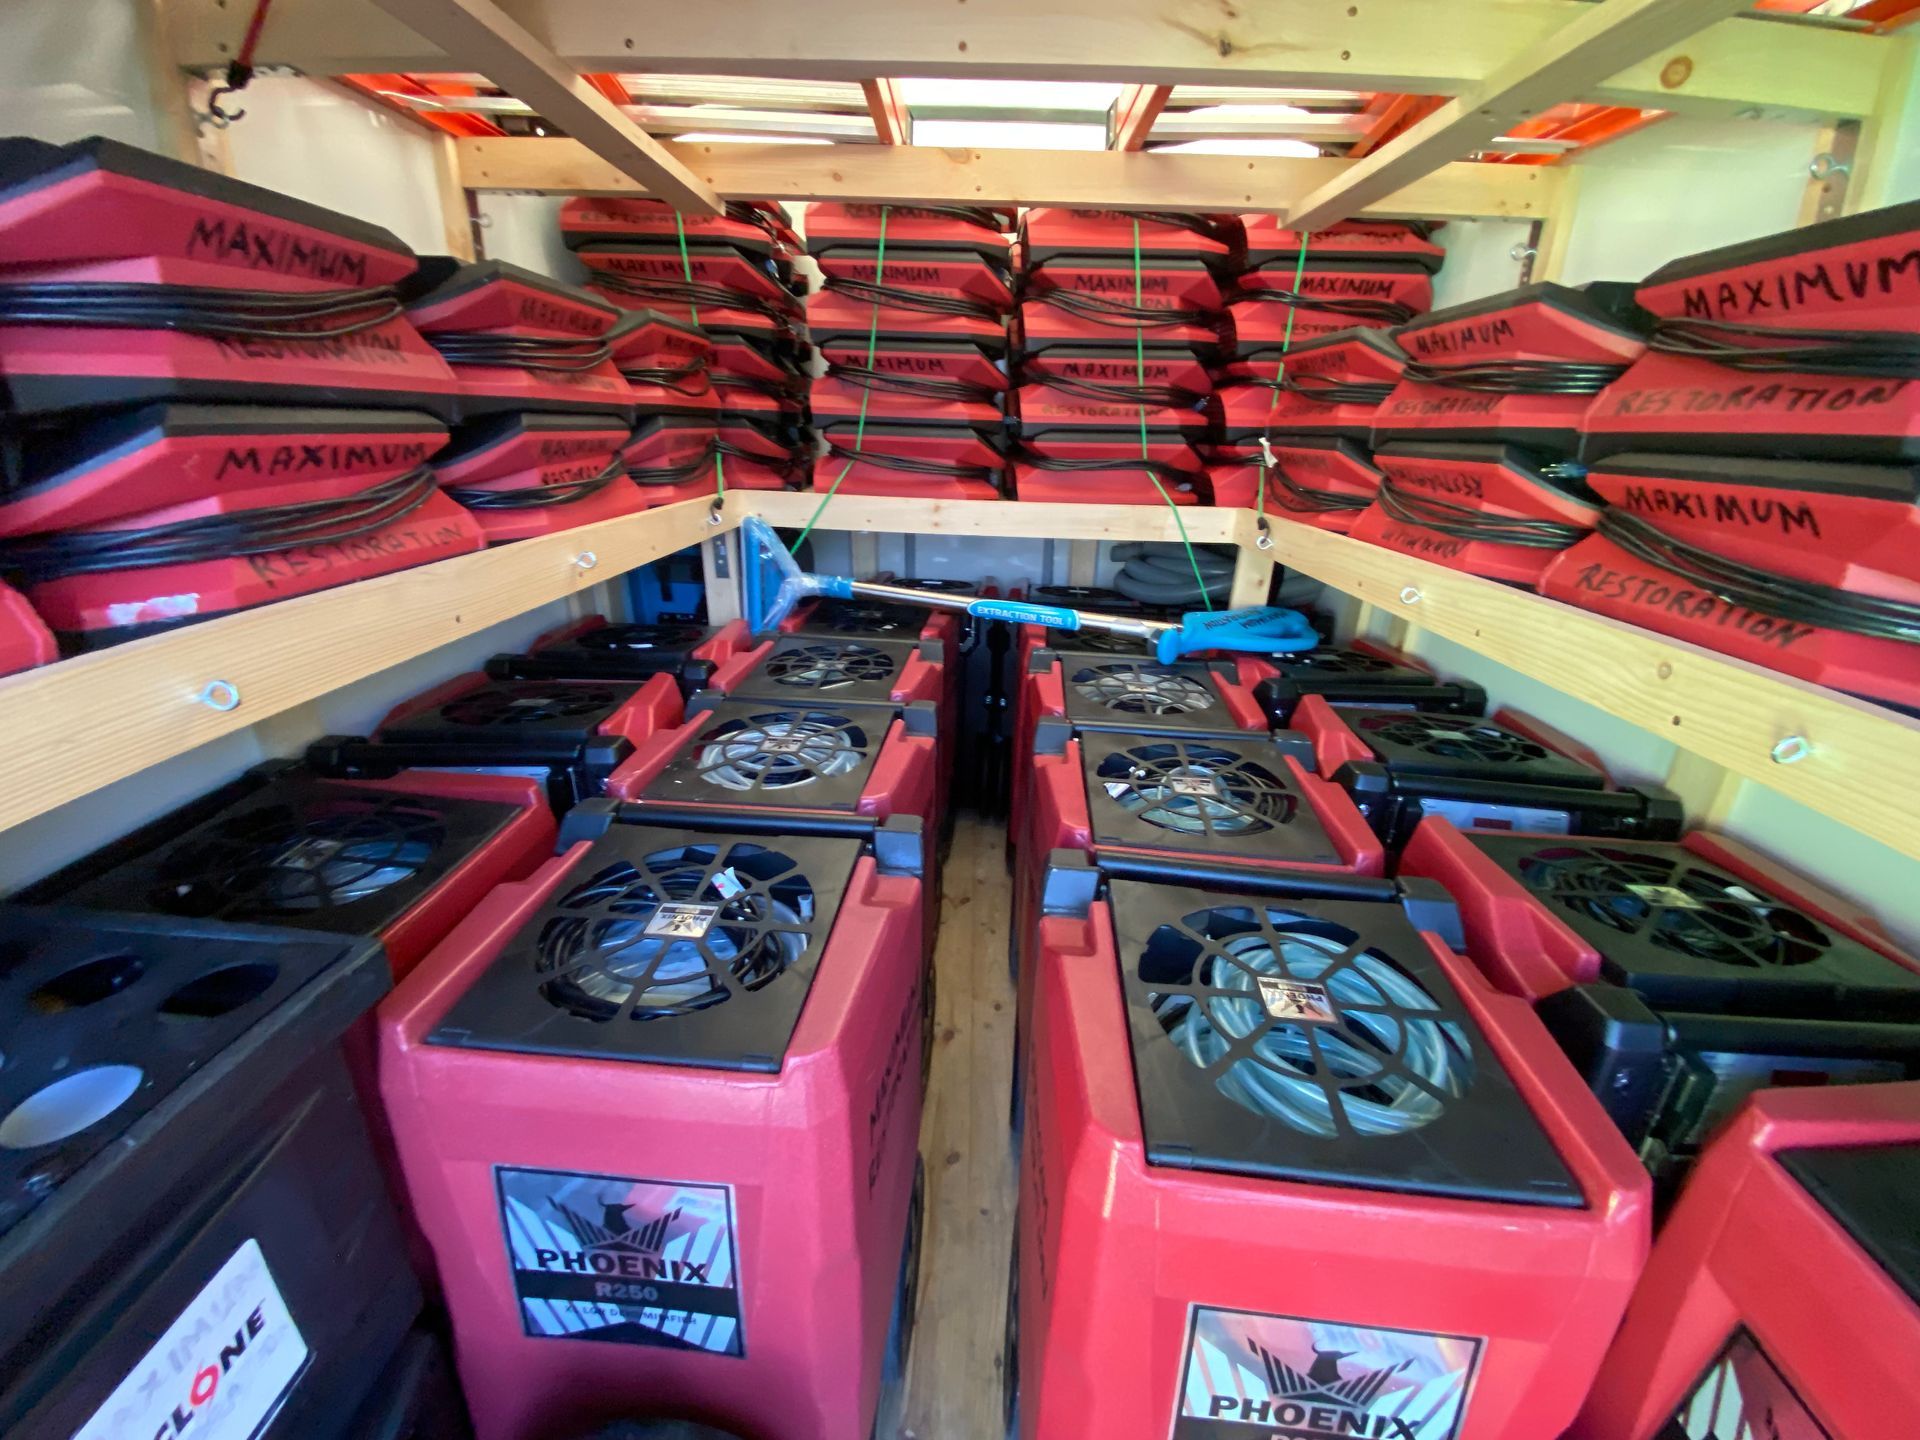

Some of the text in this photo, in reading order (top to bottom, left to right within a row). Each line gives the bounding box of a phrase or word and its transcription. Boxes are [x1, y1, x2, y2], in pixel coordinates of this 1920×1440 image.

[186, 216, 367, 287] MAXIMUM
[1299, 276, 1396, 298] MAXIMUM
[1414, 318, 1515, 354] MAXIMUM
[1612, 379, 1911, 417] RESTORATION
[215, 442, 428, 481] MAXIMUM
[1625, 485, 1821, 540] MAXIMUM
[246, 522, 465, 590] RESTORATION
[976, 606, 1064, 625] EXTRACTION TOOL
[1574, 562, 1816, 648] RESTORATION
[534, 1247, 710, 1284] PHOENIX
[594, 1280, 658, 1302] R250
[1209, 1394, 1421, 1440] PHOENIX
